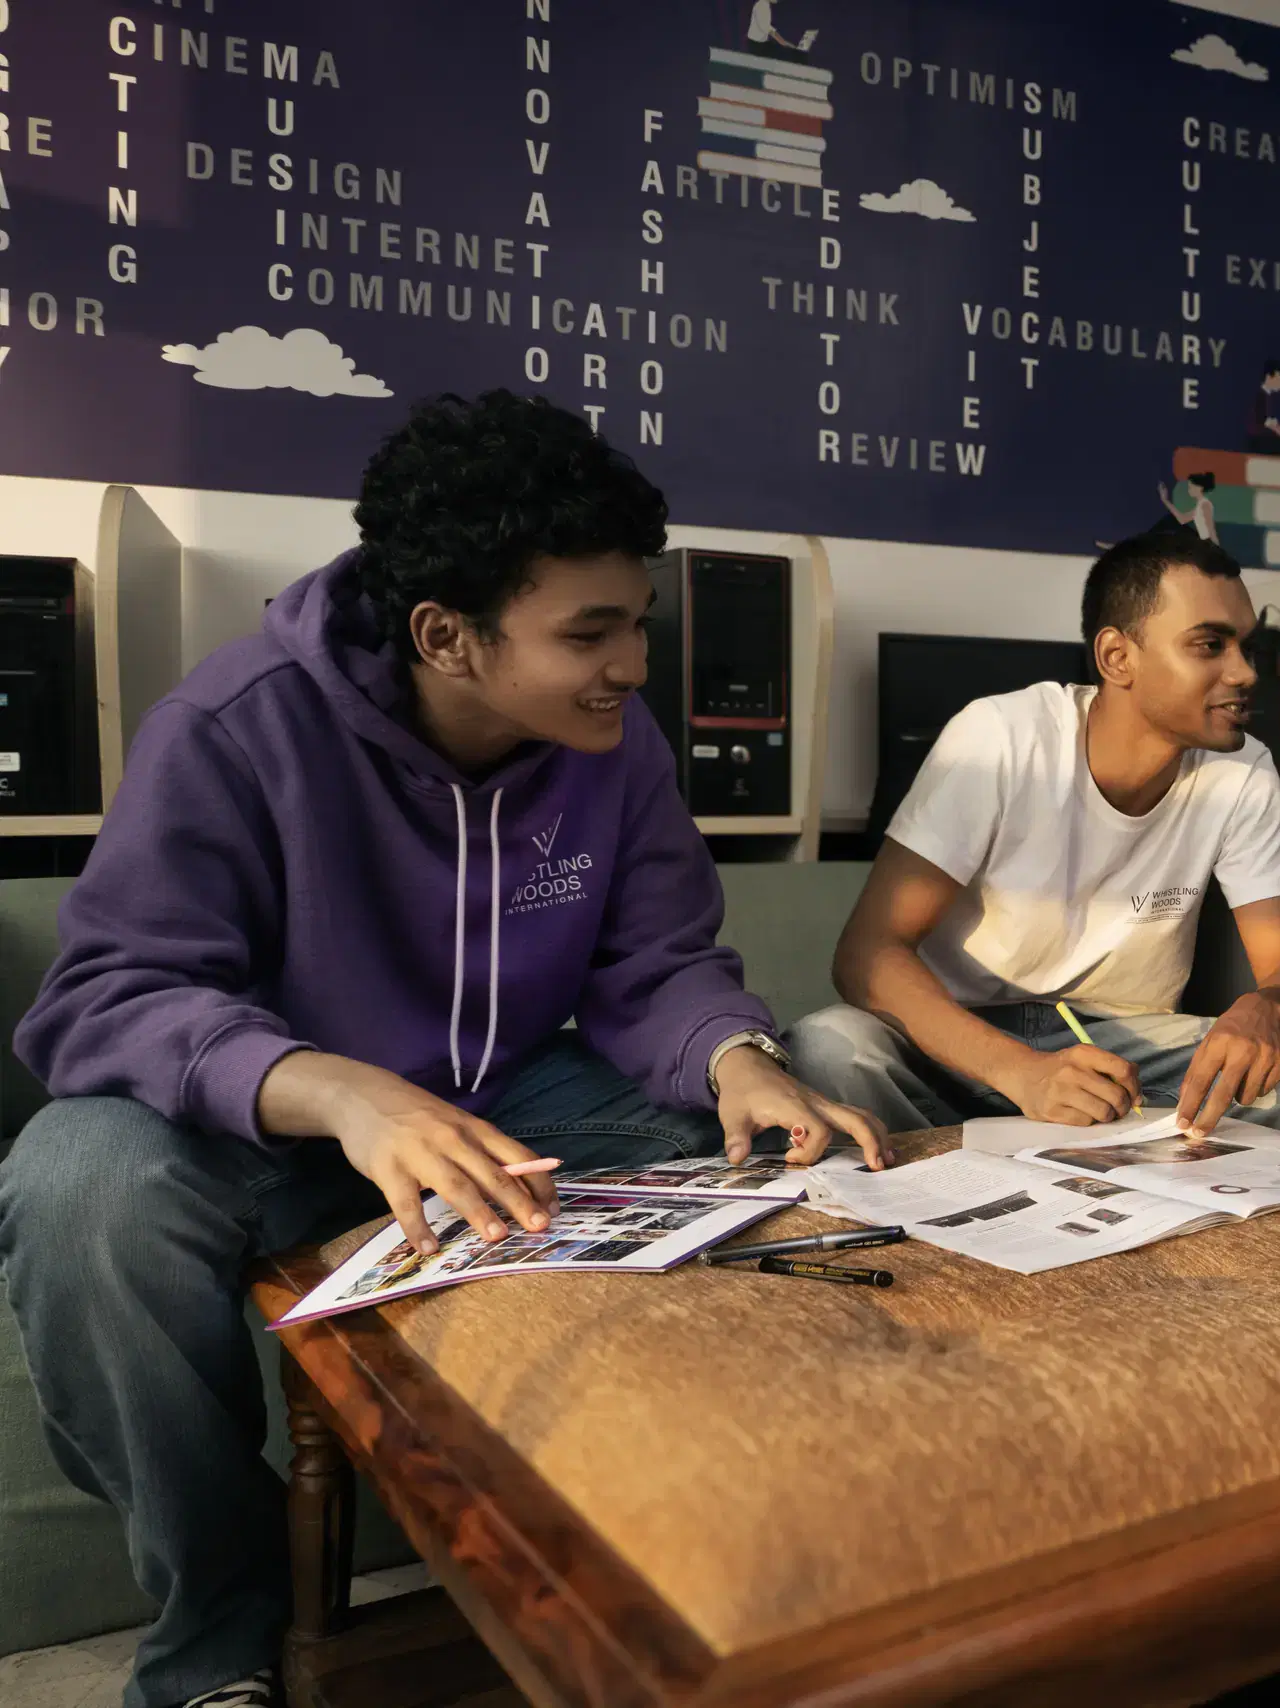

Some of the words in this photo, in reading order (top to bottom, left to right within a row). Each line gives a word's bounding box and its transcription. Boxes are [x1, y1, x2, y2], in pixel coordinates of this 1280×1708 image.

[109, 16, 340, 89] CINEMA
[860, 51, 1077, 123] OPTIMISM
[187, 141, 402, 206] DESIGN
[263, 43, 299, 301] MUSIC
[525, 0, 551, 382] NNOVATIO
[641, 160, 841, 222] ARTICLE
[276, 208, 548, 279] INTERNET
[1020, 81, 1042, 389] SUBJECT
[1182, 116, 1201, 409] CULTURE
[268, 263, 727, 353] COMMUNICATION
[640, 109, 664, 446] FASHION
[762, 276, 899, 325] THINK
[818, 189, 841, 464] EDITOR
[962, 303, 1227, 367] VOCABULARY
[583, 303, 608, 439] ART
[956, 303, 987, 476] VIEW
[818, 429, 987, 476] REVIEW
[504, 892, 588, 915] INTERNATIONAL
[1151, 897, 1181, 910] WOODS
[1152, 887, 1199, 899] WHISTLING
